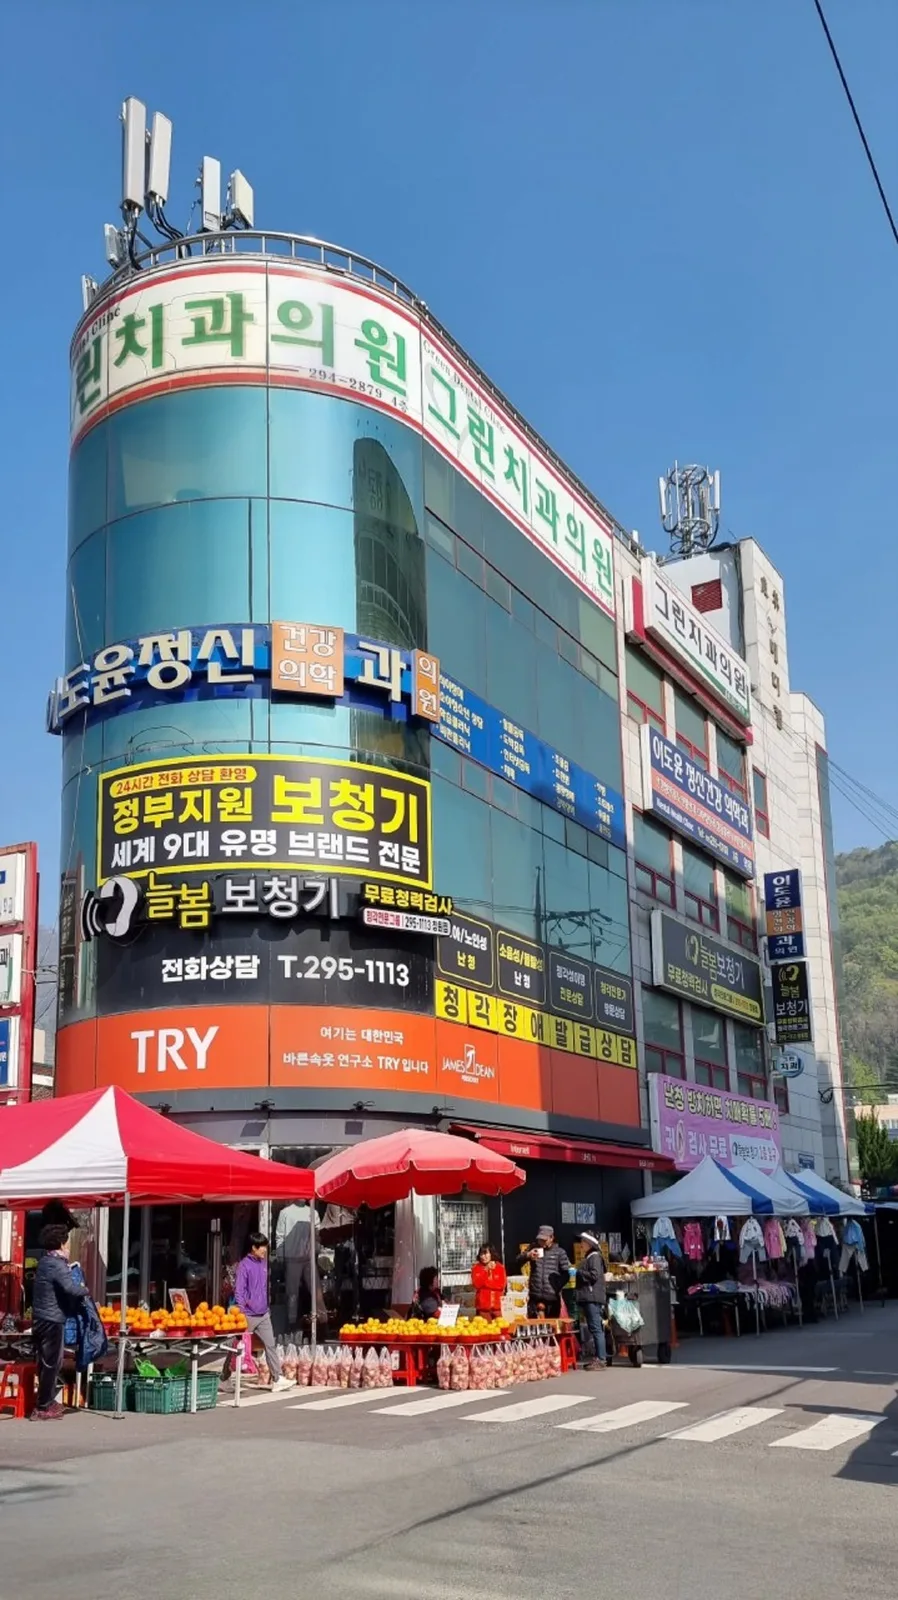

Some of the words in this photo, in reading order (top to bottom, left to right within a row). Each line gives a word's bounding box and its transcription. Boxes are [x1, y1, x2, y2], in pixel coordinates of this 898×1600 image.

[309, 367, 382, 399] 294-2879
[428, 366, 612, 598] 그린치과의원
[280, 624, 336, 657] 건강
[655, 580, 747, 701] 그린치과의원
[279, 660, 336, 692] 의학
[355, 641, 406, 702] 과
[116, 777, 154, 796] 24시간
[158, 773, 183, 786] 전화
[188, 769, 215, 783] 상담
[219, 767, 247, 781] 환영
[653, 735, 684, 784] 이도윤
[685, 761, 722, 813] 정신건강
[724, 793, 749, 834] 의학과
[113, 787, 253, 835] 정부지원
[271, 774, 418, 844] 보청기
[111, 836, 155, 869] 세계
[163, 830, 209, 861] 9대
[219, 829, 277, 857] 유명
[288, 831, 370, 863] 브랜드
[378, 840, 420, 875] 전문
[146, 871, 211, 929] 늘봄
[222, 876, 340, 920] 보청기
[364, 883, 453, 916] 무료청력검사
[772, 874, 791, 909] 이도윤
[161, 956, 261, 983] 전화상담
[277, 955, 410, 987] T.295-1113
[667, 962, 708, 996] 무료청력검사
[776, 999, 808, 1016] 보청기
[131, 1026, 219, 1074] TRY
[320, 1026, 357, 1041] 여기는
[361, 1029, 404, 1045] 대한민국
[283, 1052, 335, 1067] 바른속옷
[338, 1053, 373, 1068] 연구소
[377, 1056, 400, 1070] TRY
[402, 1058, 429, 1074] 입니다
[442, 1056, 466, 1074] JAMES
[475, 1063, 496, 1078] DEAN
[663, 1082, 685, 1112] 난청
[687, 1088, 722, 1120] 방치하면
